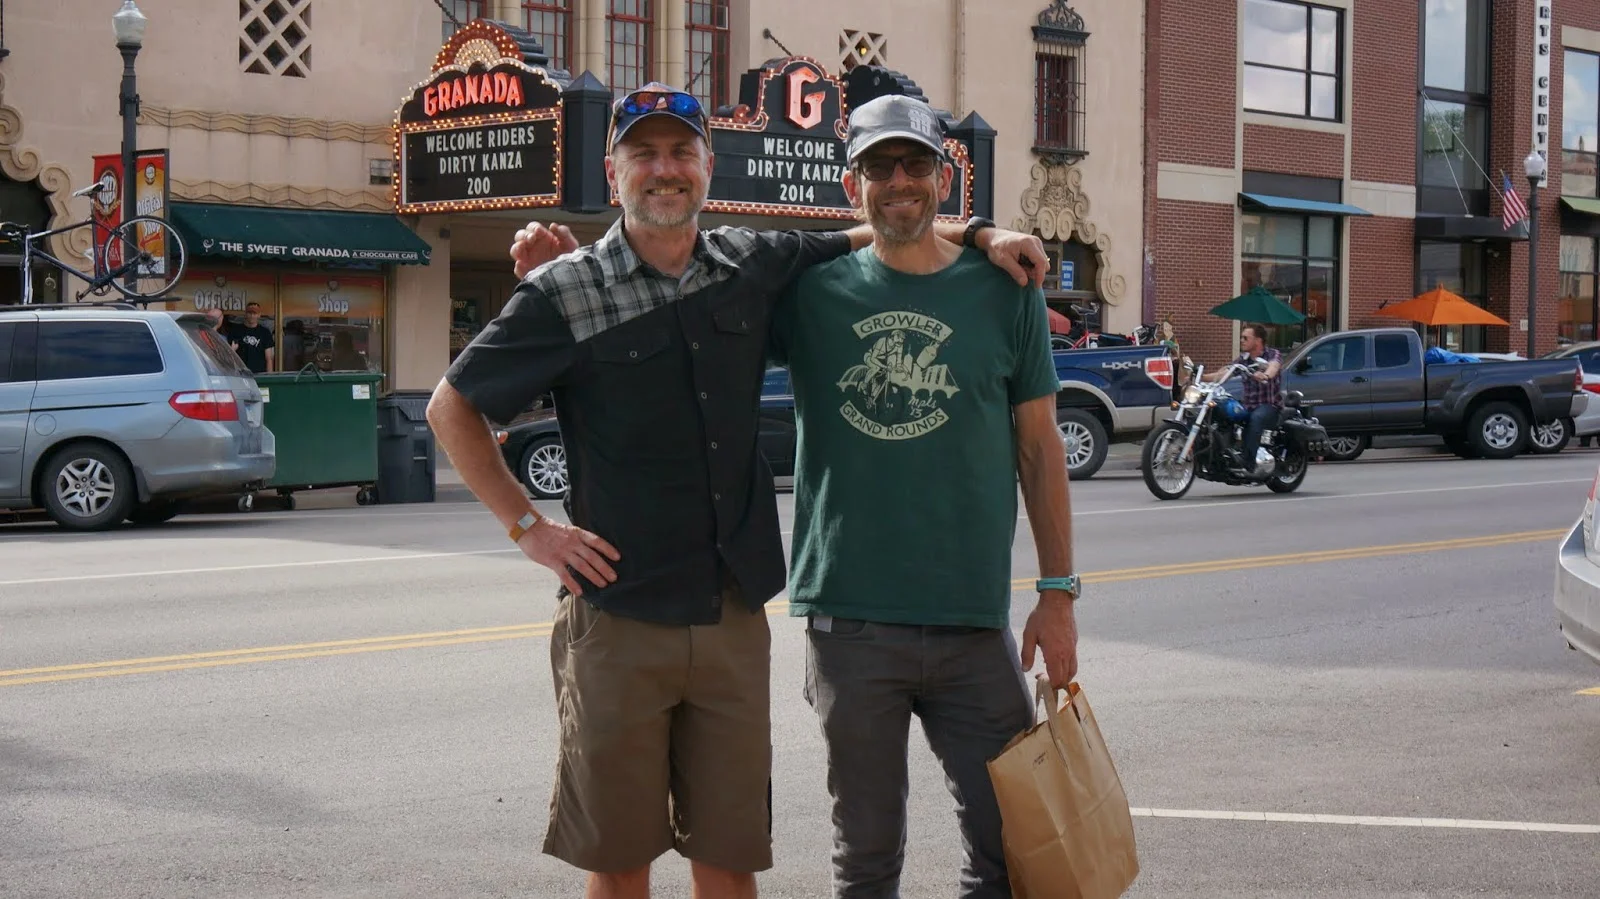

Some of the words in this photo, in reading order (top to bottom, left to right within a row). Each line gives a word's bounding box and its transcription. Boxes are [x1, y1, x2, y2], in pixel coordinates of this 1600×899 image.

[423, 72, 524, 116] GRANADA
[787, 66, 826, 130] G
[426, 131, 483, 153] WELCOME
[488, 126, 535, 147] RIDERS
[763, 137, 835, 160] WELCOME
[439, 155, 476, 174] DIRTY
[482, 151, 523, 171] KANZA
[747, 158, 794, 179] DIRTY
[467, 177, 491, 195] 200
[779, 184, 815, 203] 2014
[219, 241, 243, 253] THE
[247, 243, 287, 255] SWEET
[292, 247, 350, 258] GRANADA
[359, 251, 400, 260] CHOCOLATE
[194, 289, 247, 312] Official
[318, 293, 349, 315] Shop
[860, 314, 943, 337] GROWLER
[842, 404, 882, 435] GRAND
[886, 411, 946, 437] ROUNDS
